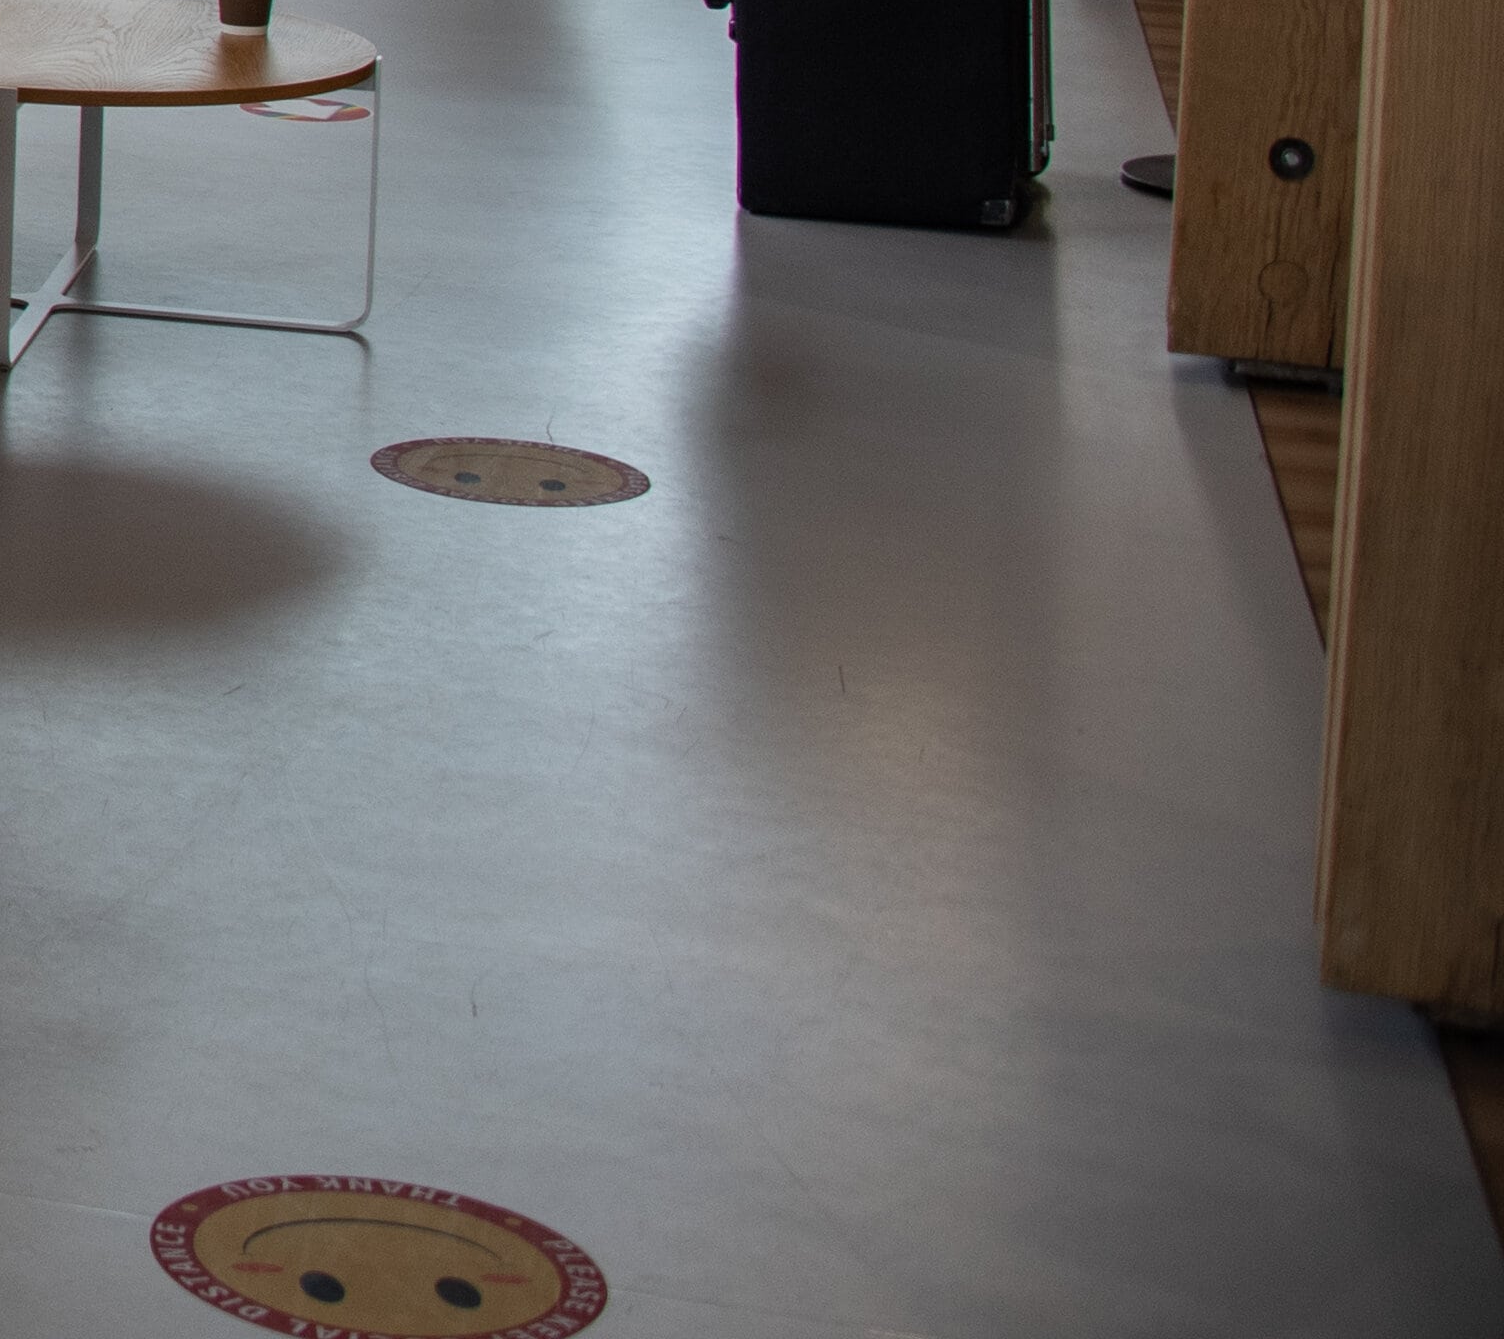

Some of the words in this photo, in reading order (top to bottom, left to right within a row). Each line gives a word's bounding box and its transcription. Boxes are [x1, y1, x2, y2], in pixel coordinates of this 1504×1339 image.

[220, 1177, 304, 1200] YOU
[318, 1175, 463, 1209] THANK
[156, 1220, 270, 1322] DISTANCE
[543, 1237, 602, 1313] PLEASE
